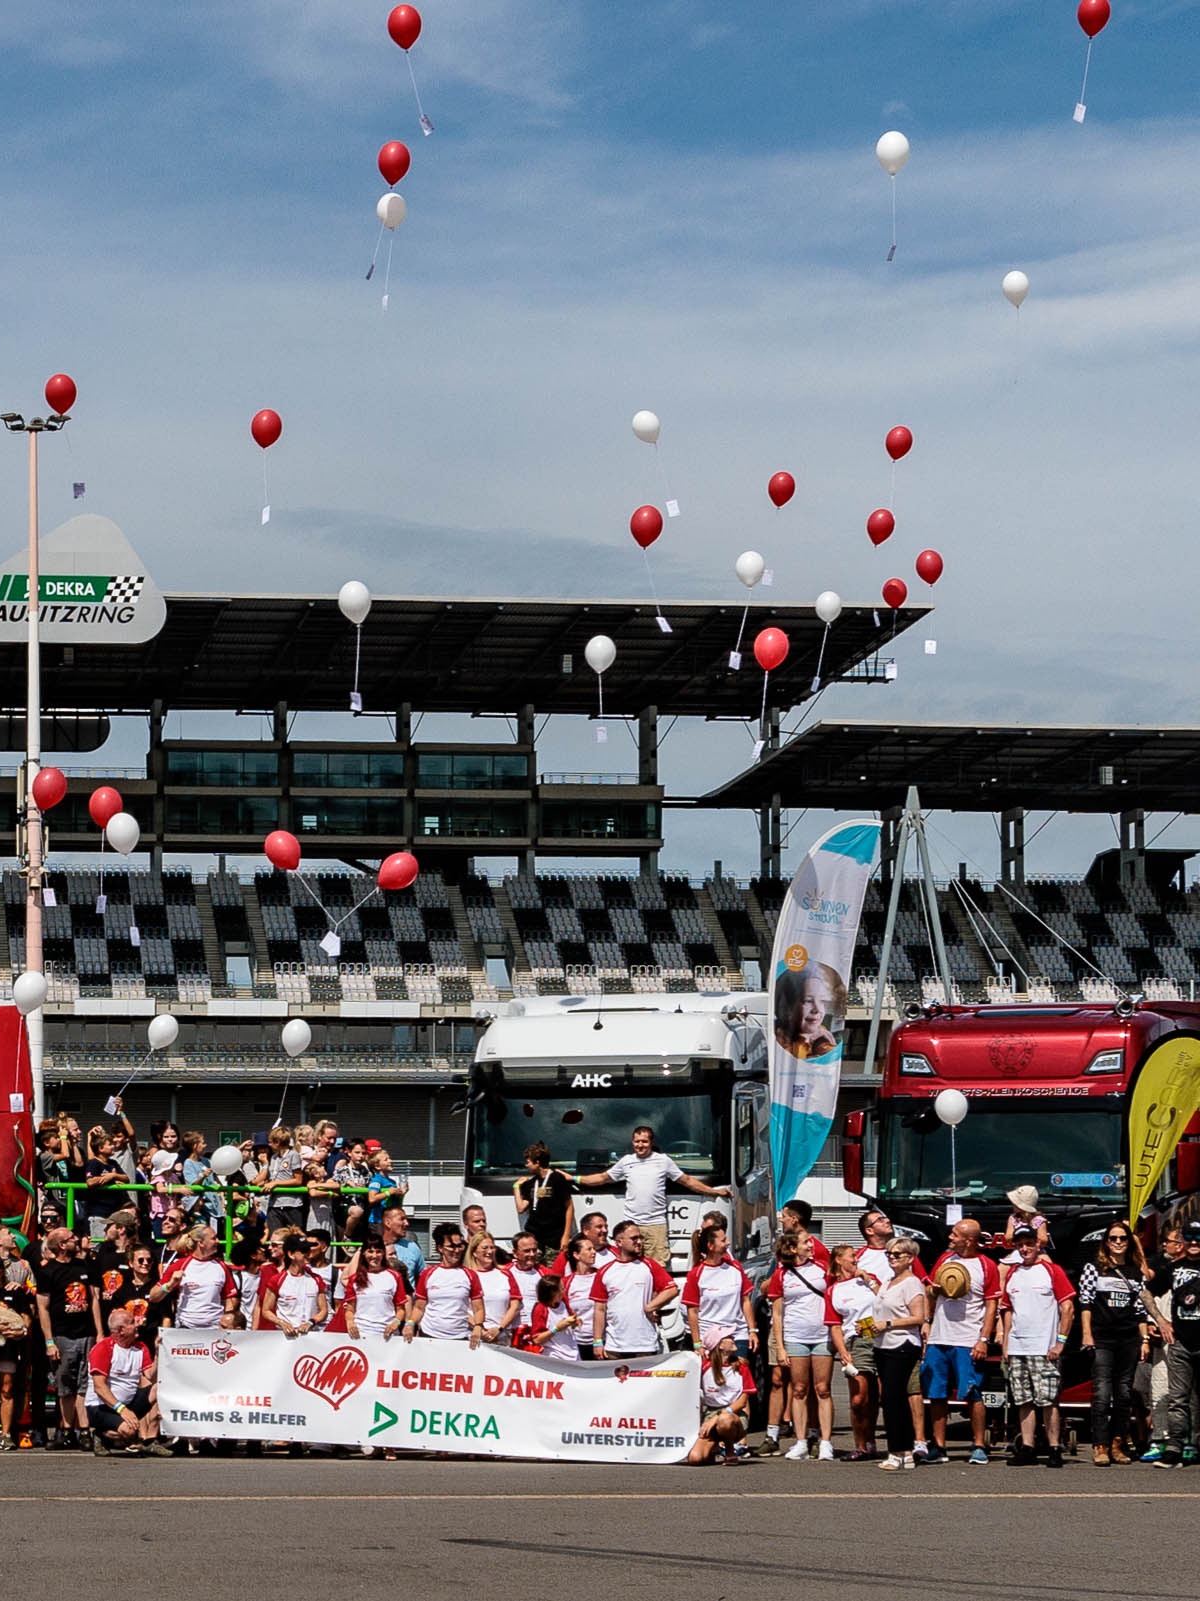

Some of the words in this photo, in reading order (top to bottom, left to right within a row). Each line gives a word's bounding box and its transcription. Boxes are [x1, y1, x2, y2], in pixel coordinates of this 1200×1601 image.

[45, 581, 96, 596] DEKRA
[571, 1073, 612, 1088] AHC
[171, 1347, 210, 1356] FEELING
[376, 1369, 474, 1394] LICHEN
[483, 1375, 565, 1400] DANK
[234, 1396, 272, 1407] ALLE
[170, 1409, 224, 1422] TEAMS
[229, 1411, 243, 1424] &
[248, 1411, 307, 1426] HELFER
[410, 1409, 501, 1439] DEKRA
[589, 1416, 612, 1428] AN
[617, 1417, 657, 1430] ALLE
[561, 1431, 686, 1448] UNTERSTÜTZER
